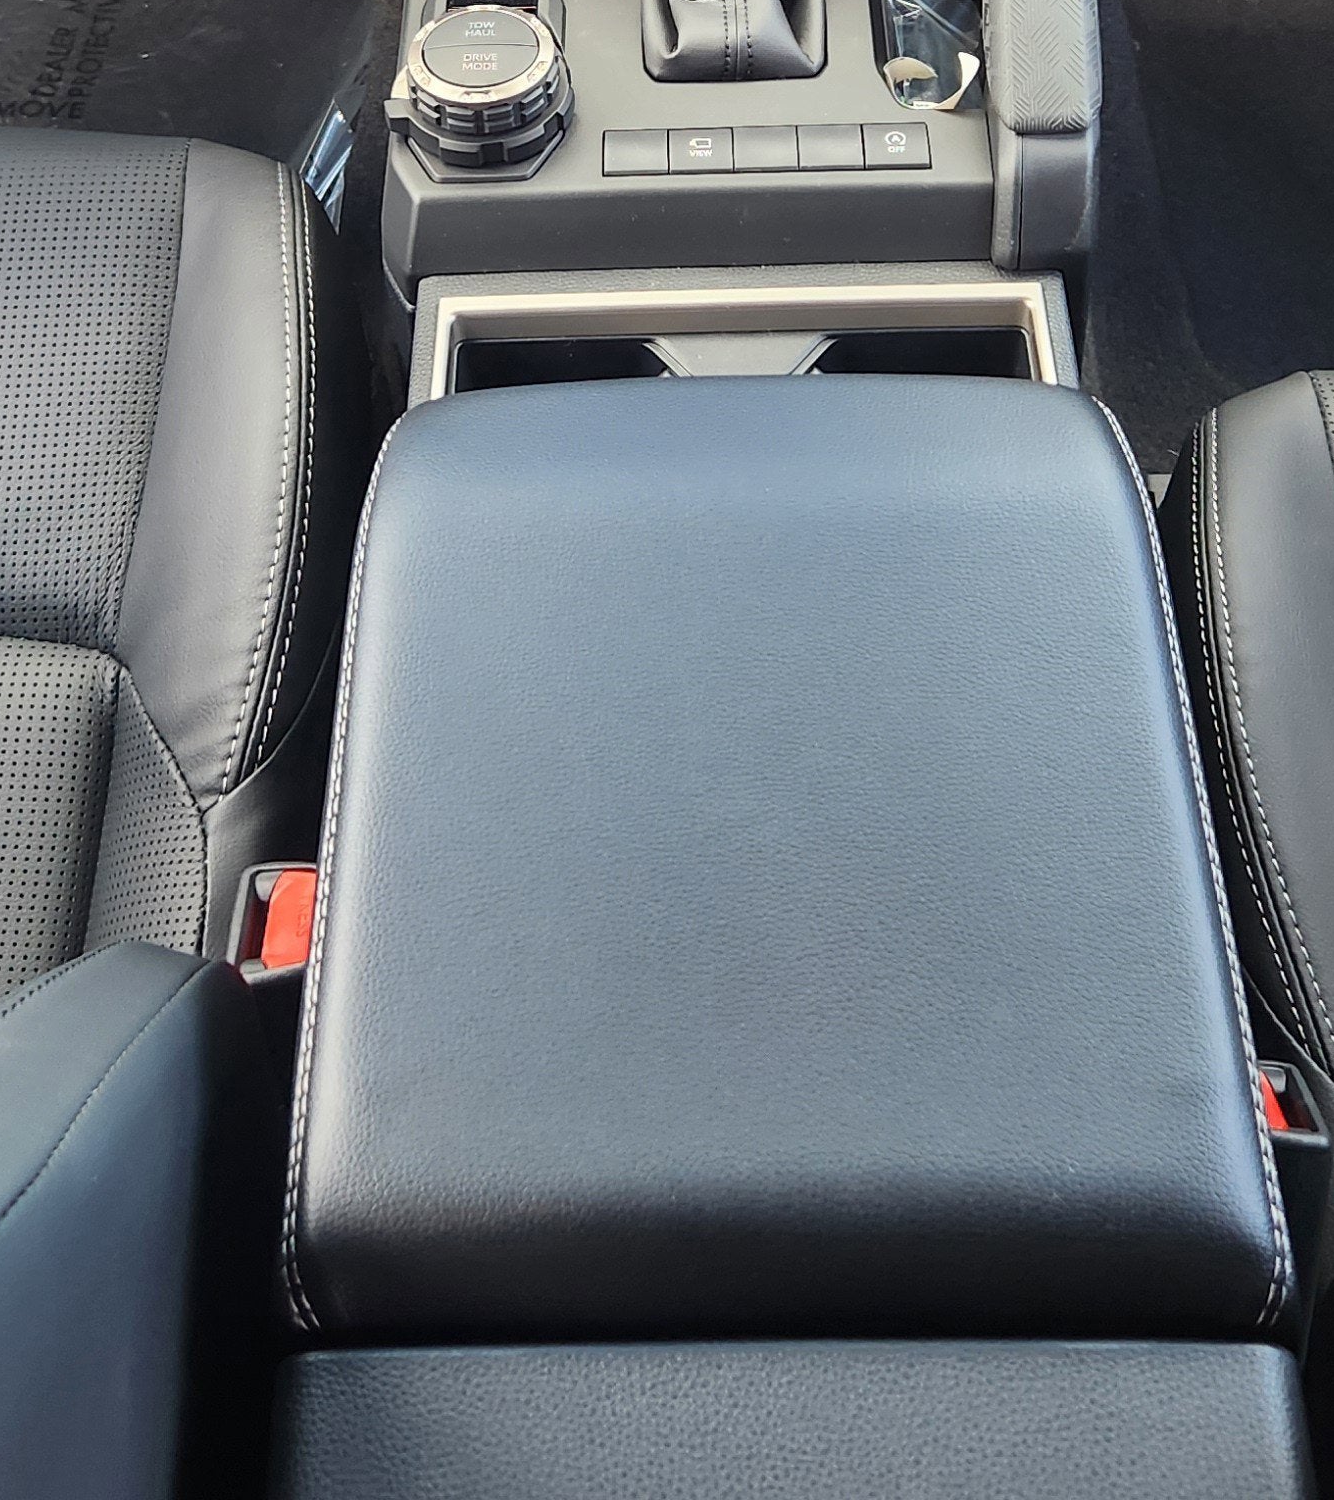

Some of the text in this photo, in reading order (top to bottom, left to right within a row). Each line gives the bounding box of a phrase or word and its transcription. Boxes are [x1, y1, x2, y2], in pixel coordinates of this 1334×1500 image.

[465, 29, 496, 37] HAUL
[30, 26, 72, 98] DEALER
[462, 62, 498, 71] MODE
[689, 149, 713, 158] VIEW
[888, 145, 906, 153] OFF
